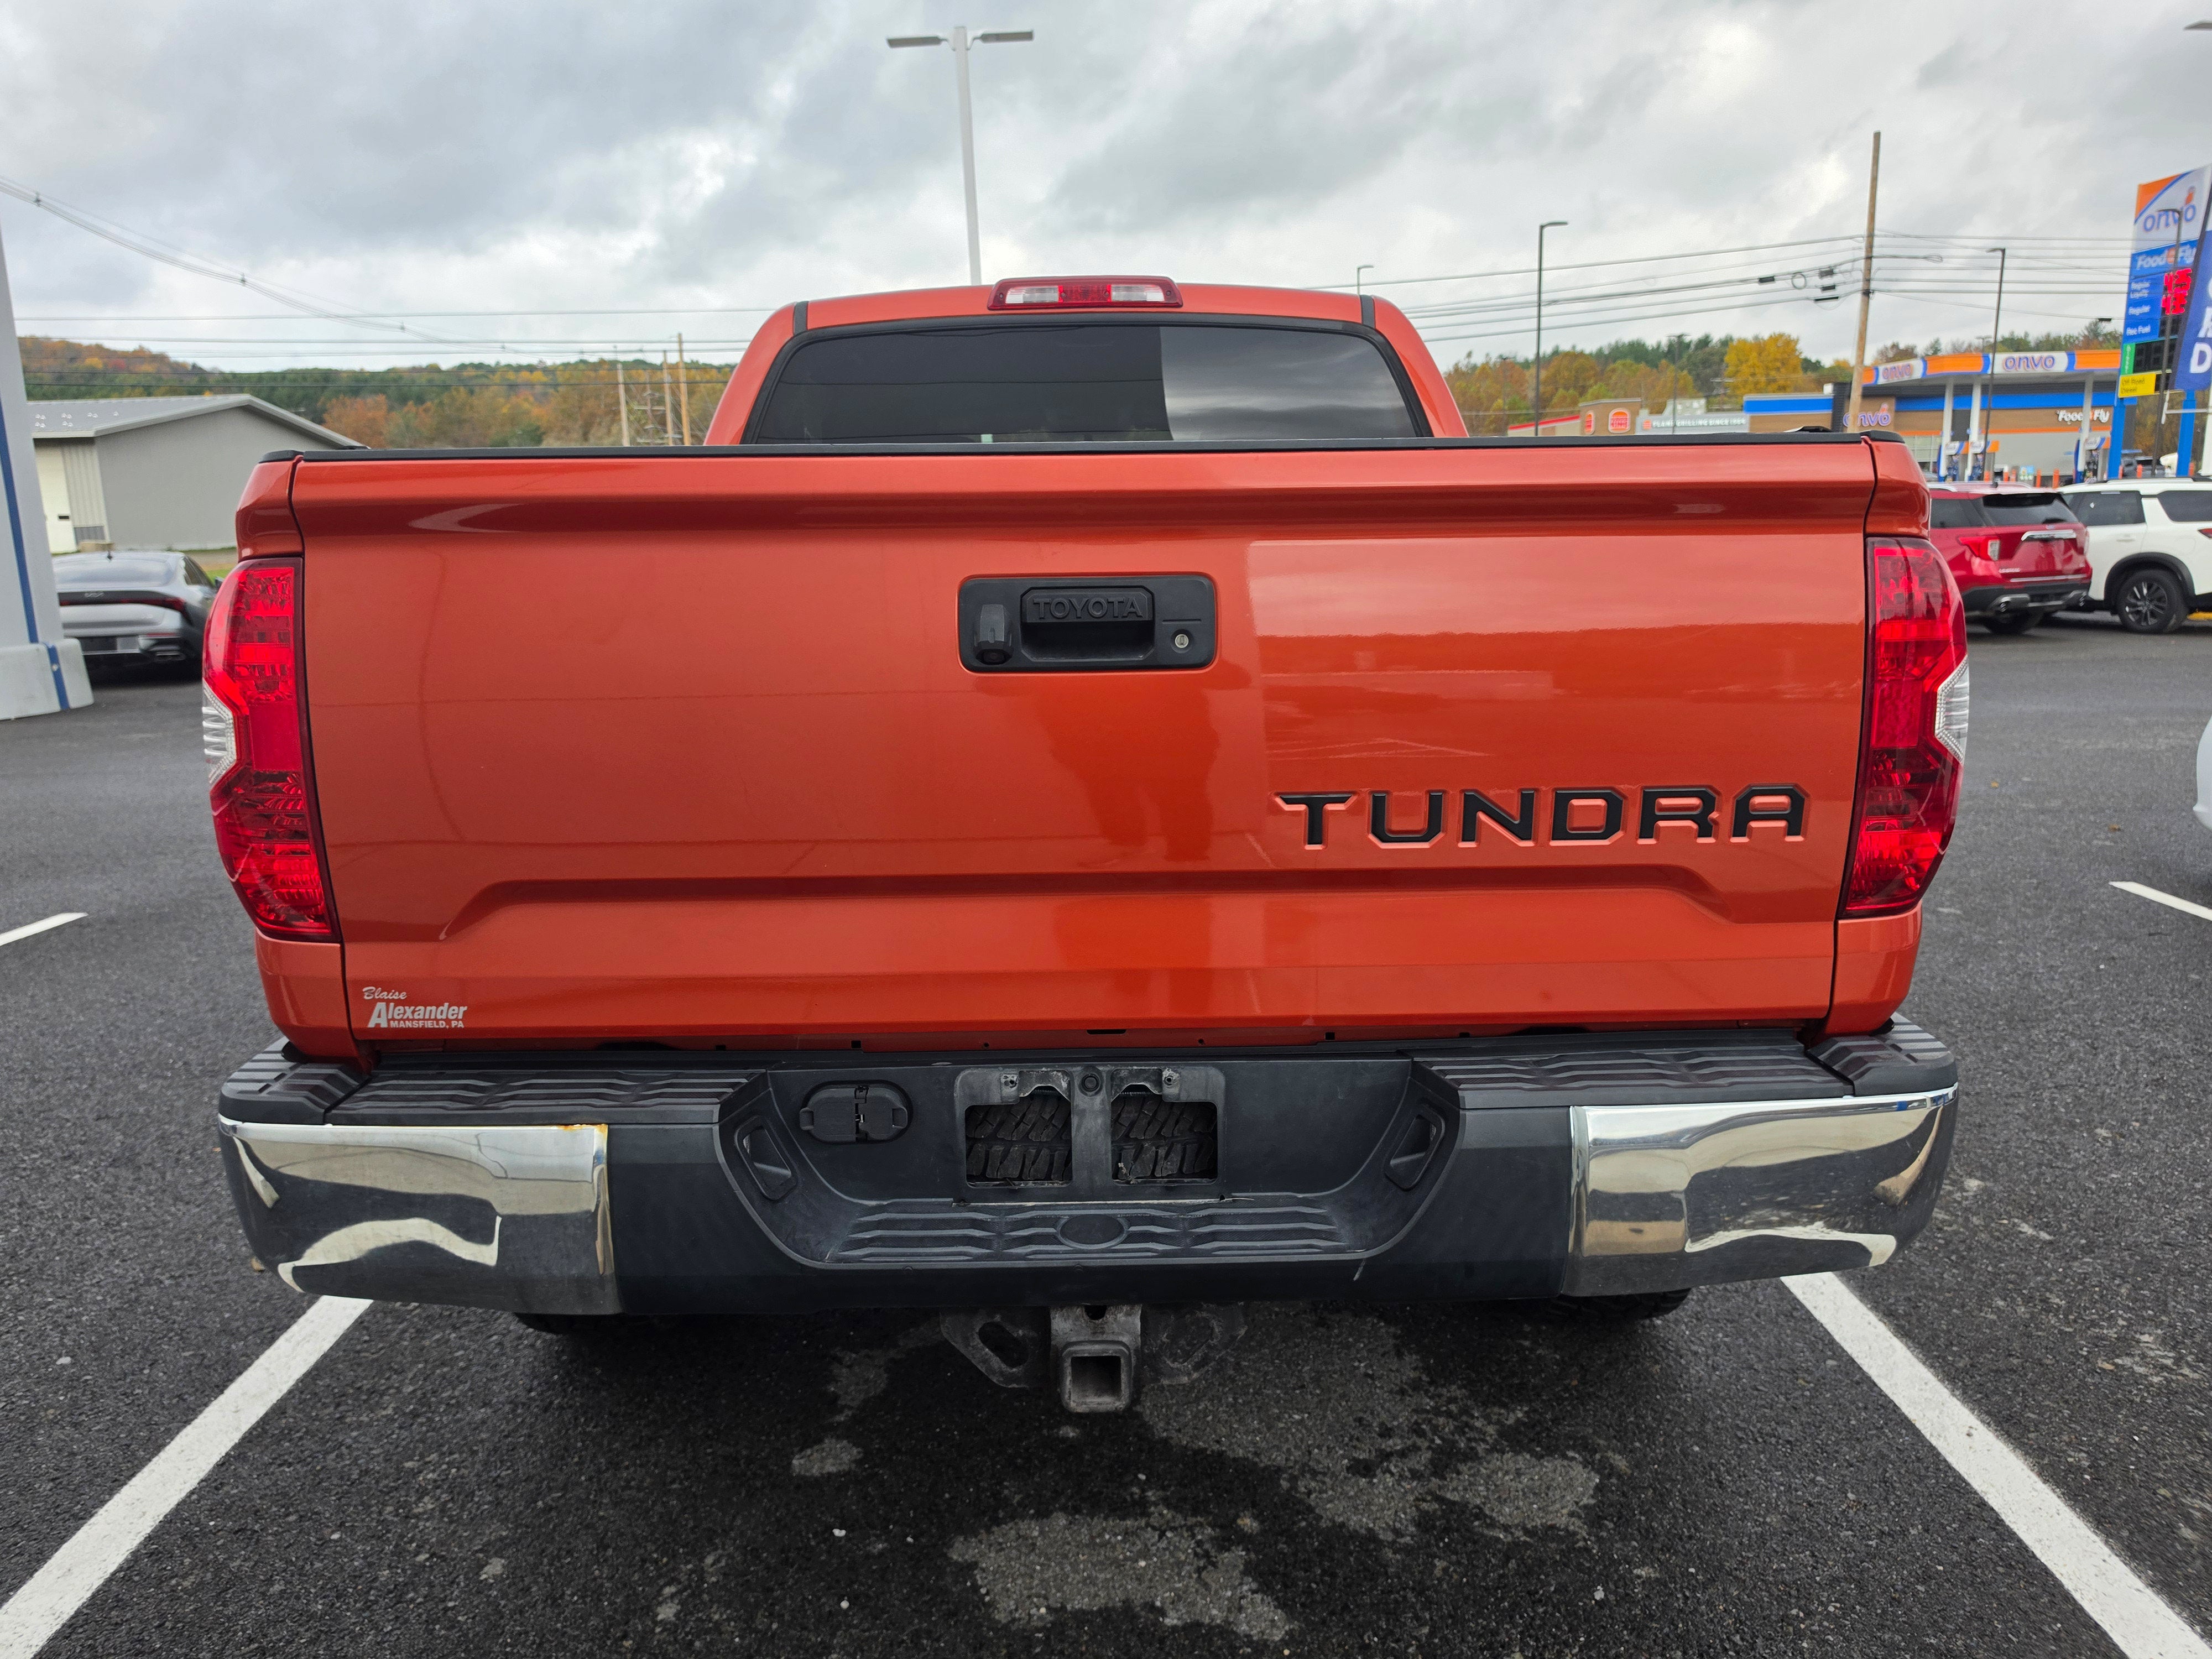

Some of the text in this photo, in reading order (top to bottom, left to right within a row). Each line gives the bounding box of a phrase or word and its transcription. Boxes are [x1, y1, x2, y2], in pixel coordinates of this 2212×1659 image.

[1882, 362, 1913, 380] onvo
[2004, 354, 2055, 371] onvo
[1032, 596, 1143, 619] TOYOTA
[1275, 783, 1810, 850] TUNDRA
[362, 986, 408, 1000] Blaise
[367, 1001, 468, 1028] Alexander
[390, 1020, 465, 1029] MANSFIELD, PA
